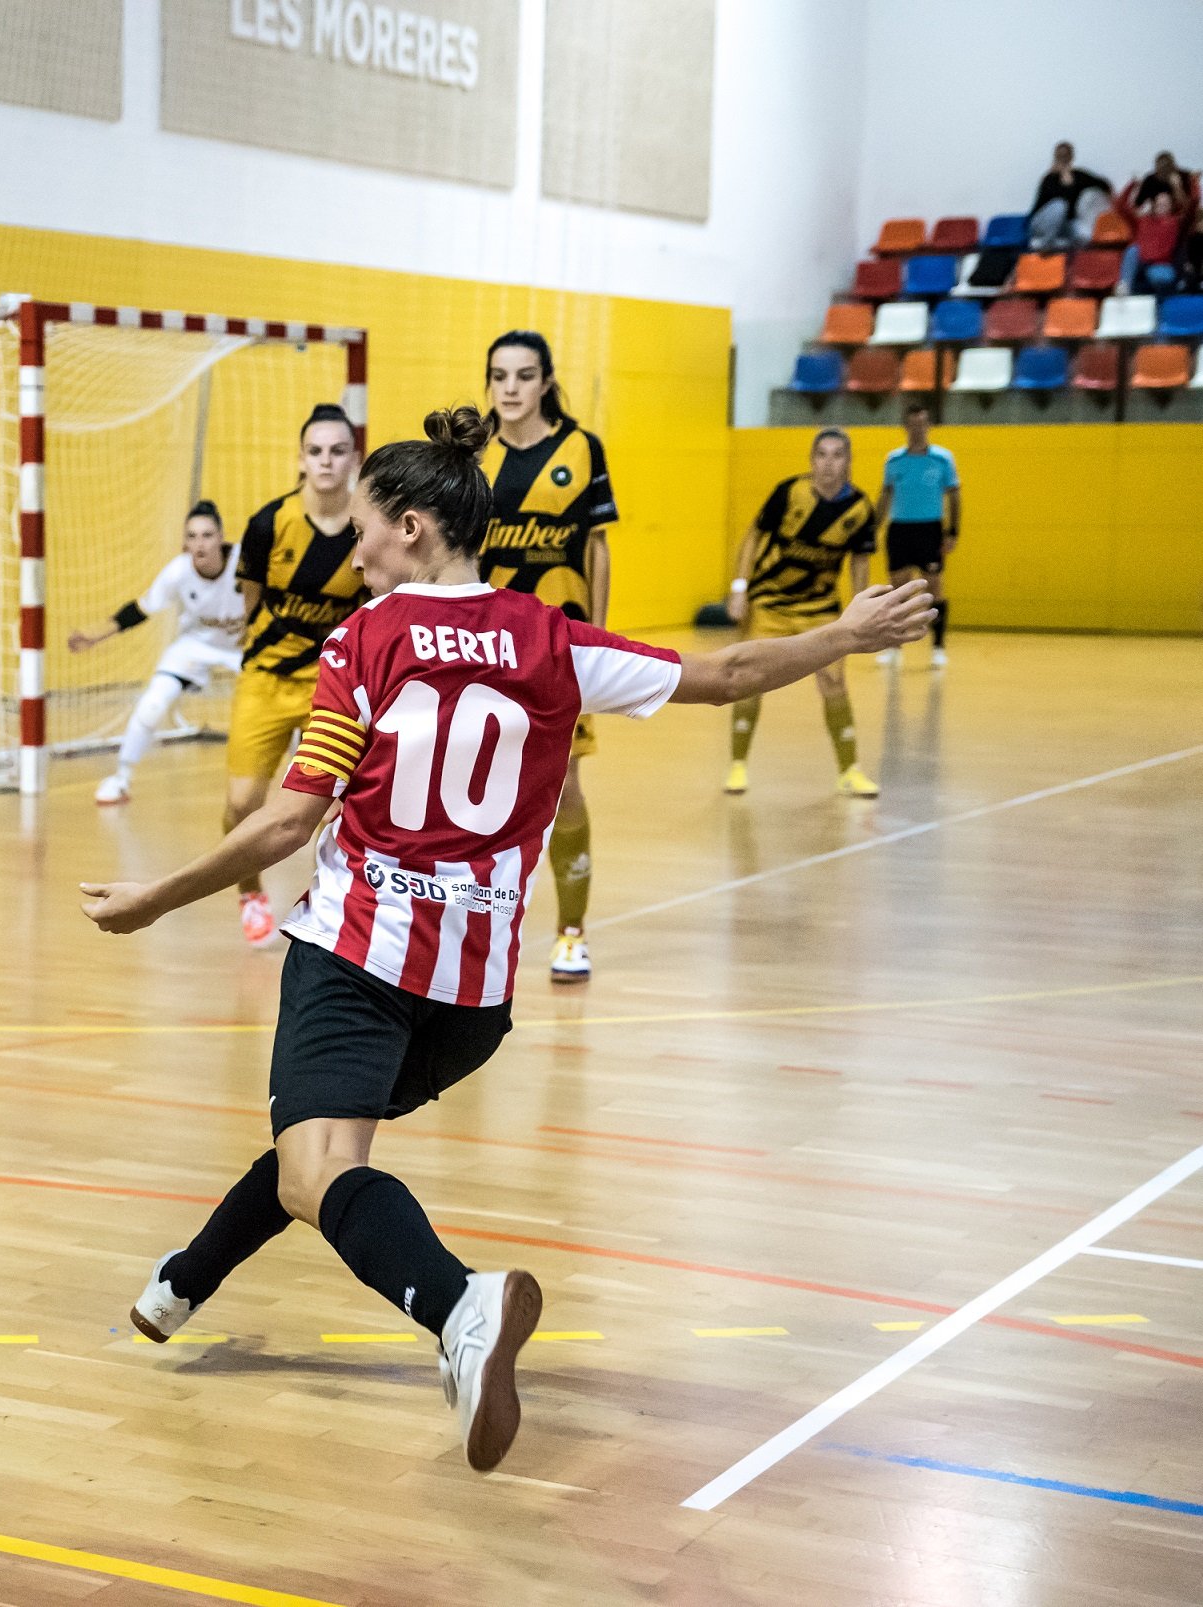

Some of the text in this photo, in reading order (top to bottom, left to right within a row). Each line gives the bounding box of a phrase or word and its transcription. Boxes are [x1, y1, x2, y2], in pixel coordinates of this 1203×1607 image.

[230, 0, 479, 89] LES MORERES
[409, 624, 518, 669] BERTA
[375, 680, 530, 835] 10
[391, 872, 446, 900] SJD
[494, 887, 506, 900] de
